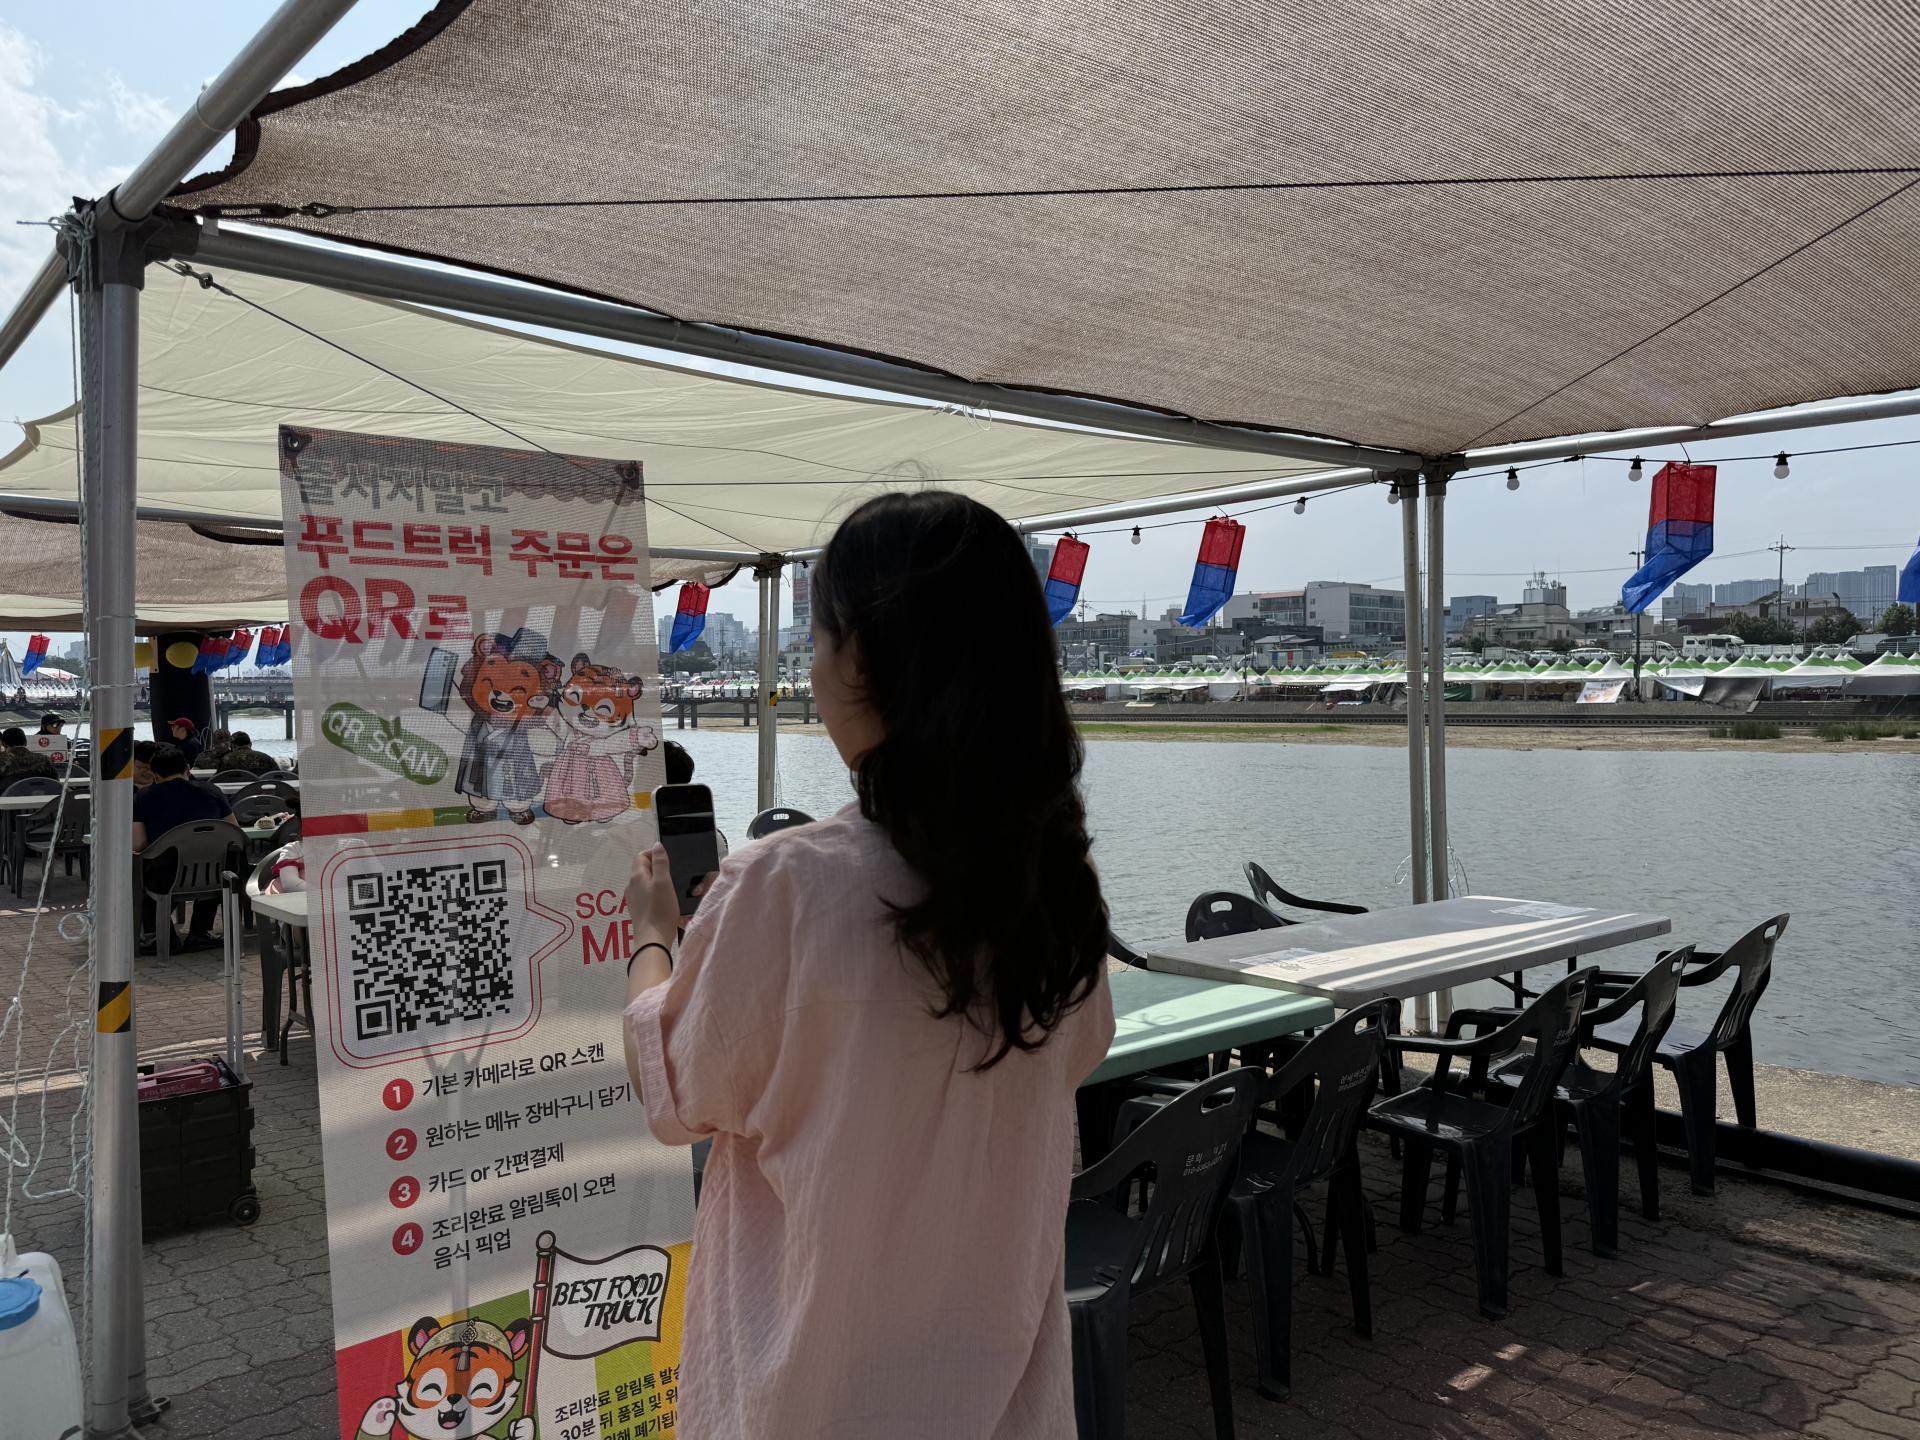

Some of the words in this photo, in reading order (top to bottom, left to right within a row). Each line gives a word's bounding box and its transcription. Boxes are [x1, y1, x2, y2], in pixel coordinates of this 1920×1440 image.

[298, 458, 509, 515] 줄서지말고
[297, 514, 493, 576] 푸드트럭
[509, 529, 639, 580] 주문은
[300, 575, 474, 644] QR로
[328, 710, 365, 743] QR
[368, 729, 440, 778] SCAN
[581, 919, 635, 965] ME
[392, 1085, 401, 1104] 1
[421, 1072, 458, 1097] 기본
[463, 1057, 534, 1088] 카메라로
[539, 1052, 566, 1072] QR
[570, 1041, 604, 1066] 스캔
[394, 1135, 408, 1154] 2
[425, 1119, 480, 1148] 원하는
[485, 1109, 520, 1132] 메뉴
[525, 1090, 592, 1123] 장바구니
[598, 1081, 630, 1108] 담기
[397, 1183, 411, 1202] 3
[428, 1168, 465, 1193] 카드
[470, 1165, 490, 1182] or
[494, 1142, 563, 1178] 간편결제
[401, 1230, 415, 1248] 4
[431, 1204, 504, 1240] 조리완료
[509, 1182, 577, 1219] 알림톡이
[582, 1173, 615, 1199] 오면
[433, 1239, 470, 1269] 음식
[475, 1228, 510, 1254] 픽업
[552, 1277, 608, 1307] BEST
[606, 1272, 664, 1300] FOOD
[584, 1296, 659, 1330] TRUCK
[554, 1390, 612, 1424] 조리완료
[615, 1373, 656, 1401] 알림톡
[560, 1418, 596, 1440] 30분
[599, 1411, 613, 1430] 뒤
[617, 1399, 645, 1424] 품질
[648, 1392, 662, 1411] 및
[634, 1410, 678, 1438] 폐기됩
